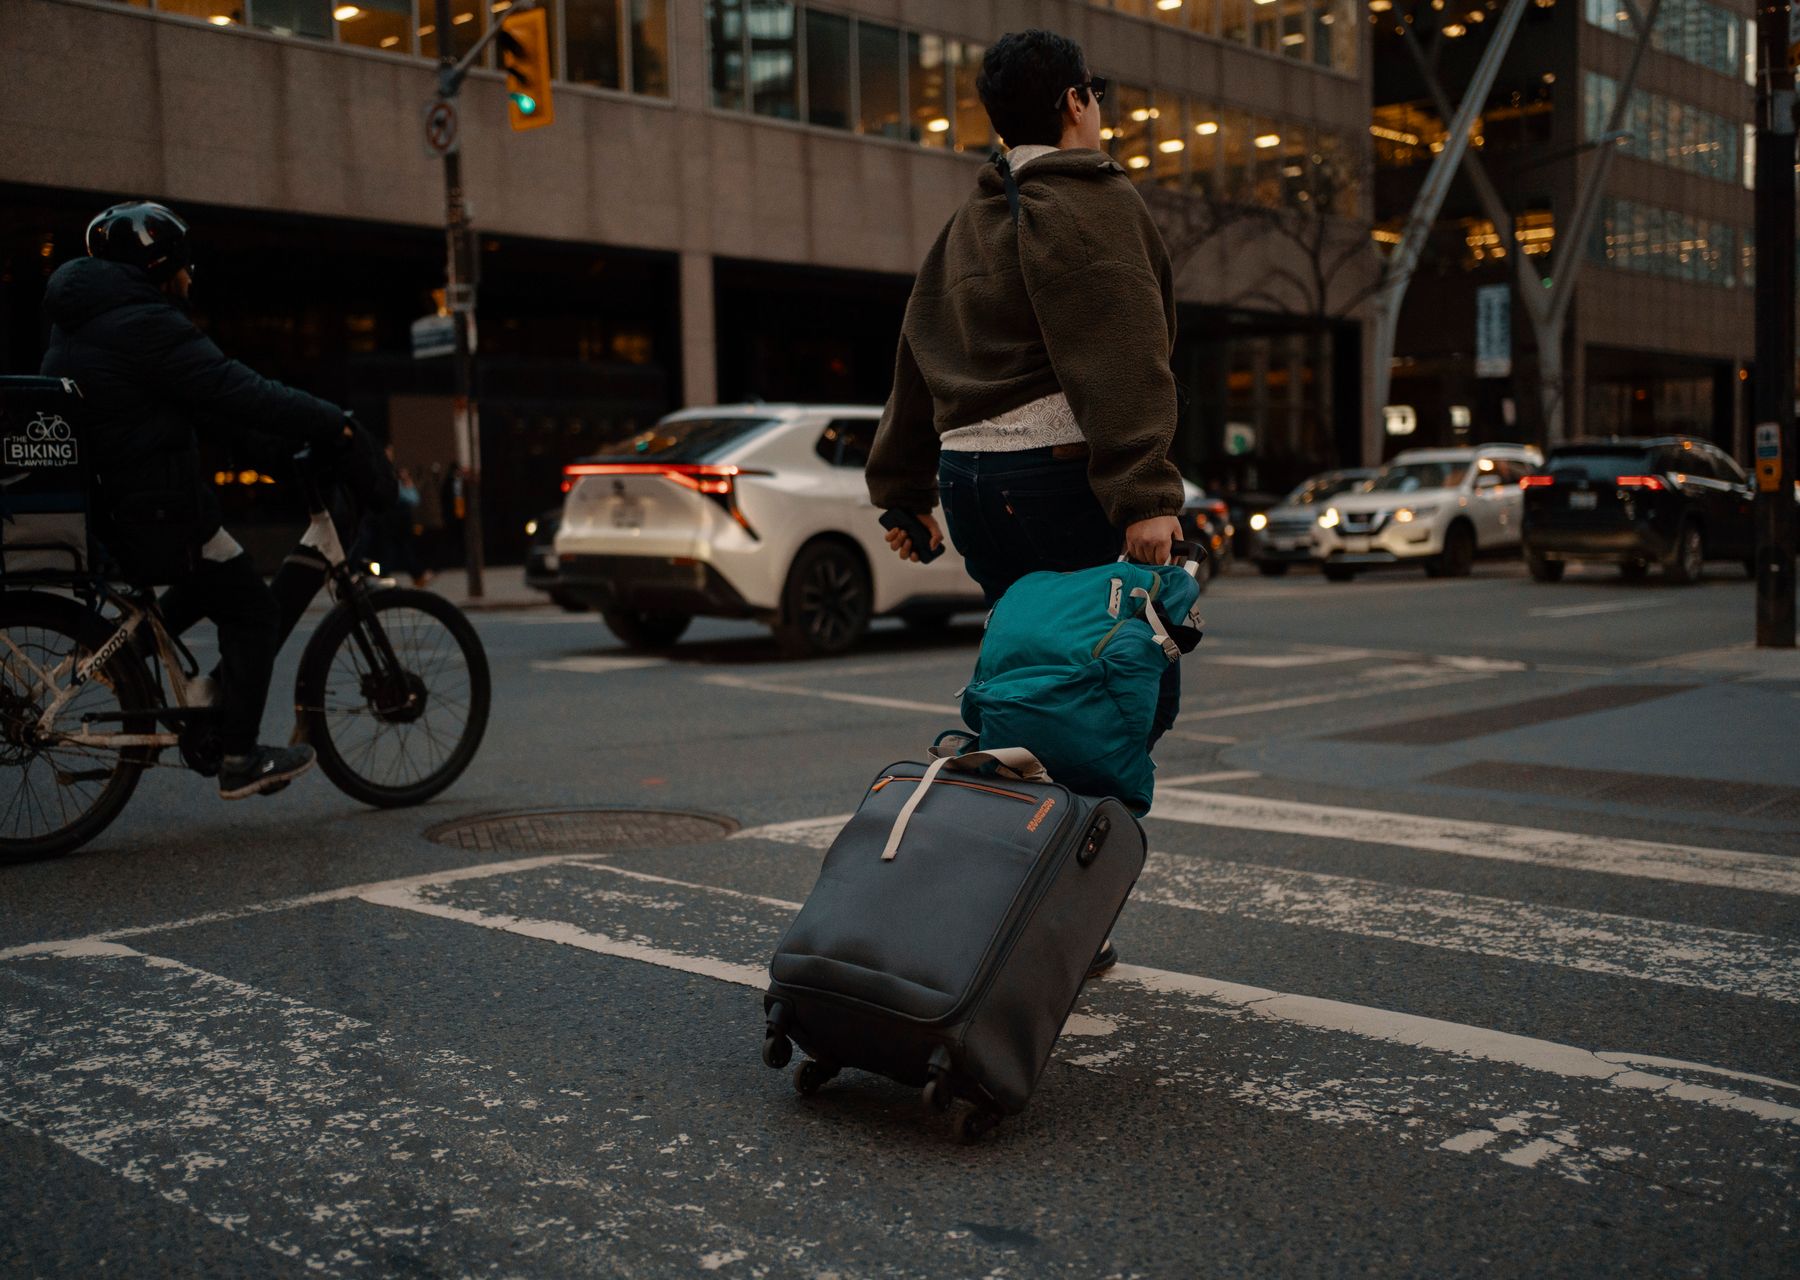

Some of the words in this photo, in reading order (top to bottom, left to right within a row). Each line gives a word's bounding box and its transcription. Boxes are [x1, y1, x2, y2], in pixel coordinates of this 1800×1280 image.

[12, 435, 27, 443] THE
[11, 444, 72, 459] BIKING
[18, 459, 53, 467] LAWYER
[54, 459, 68, 467] LLP
[87, 629, 128, 676] zoomo
